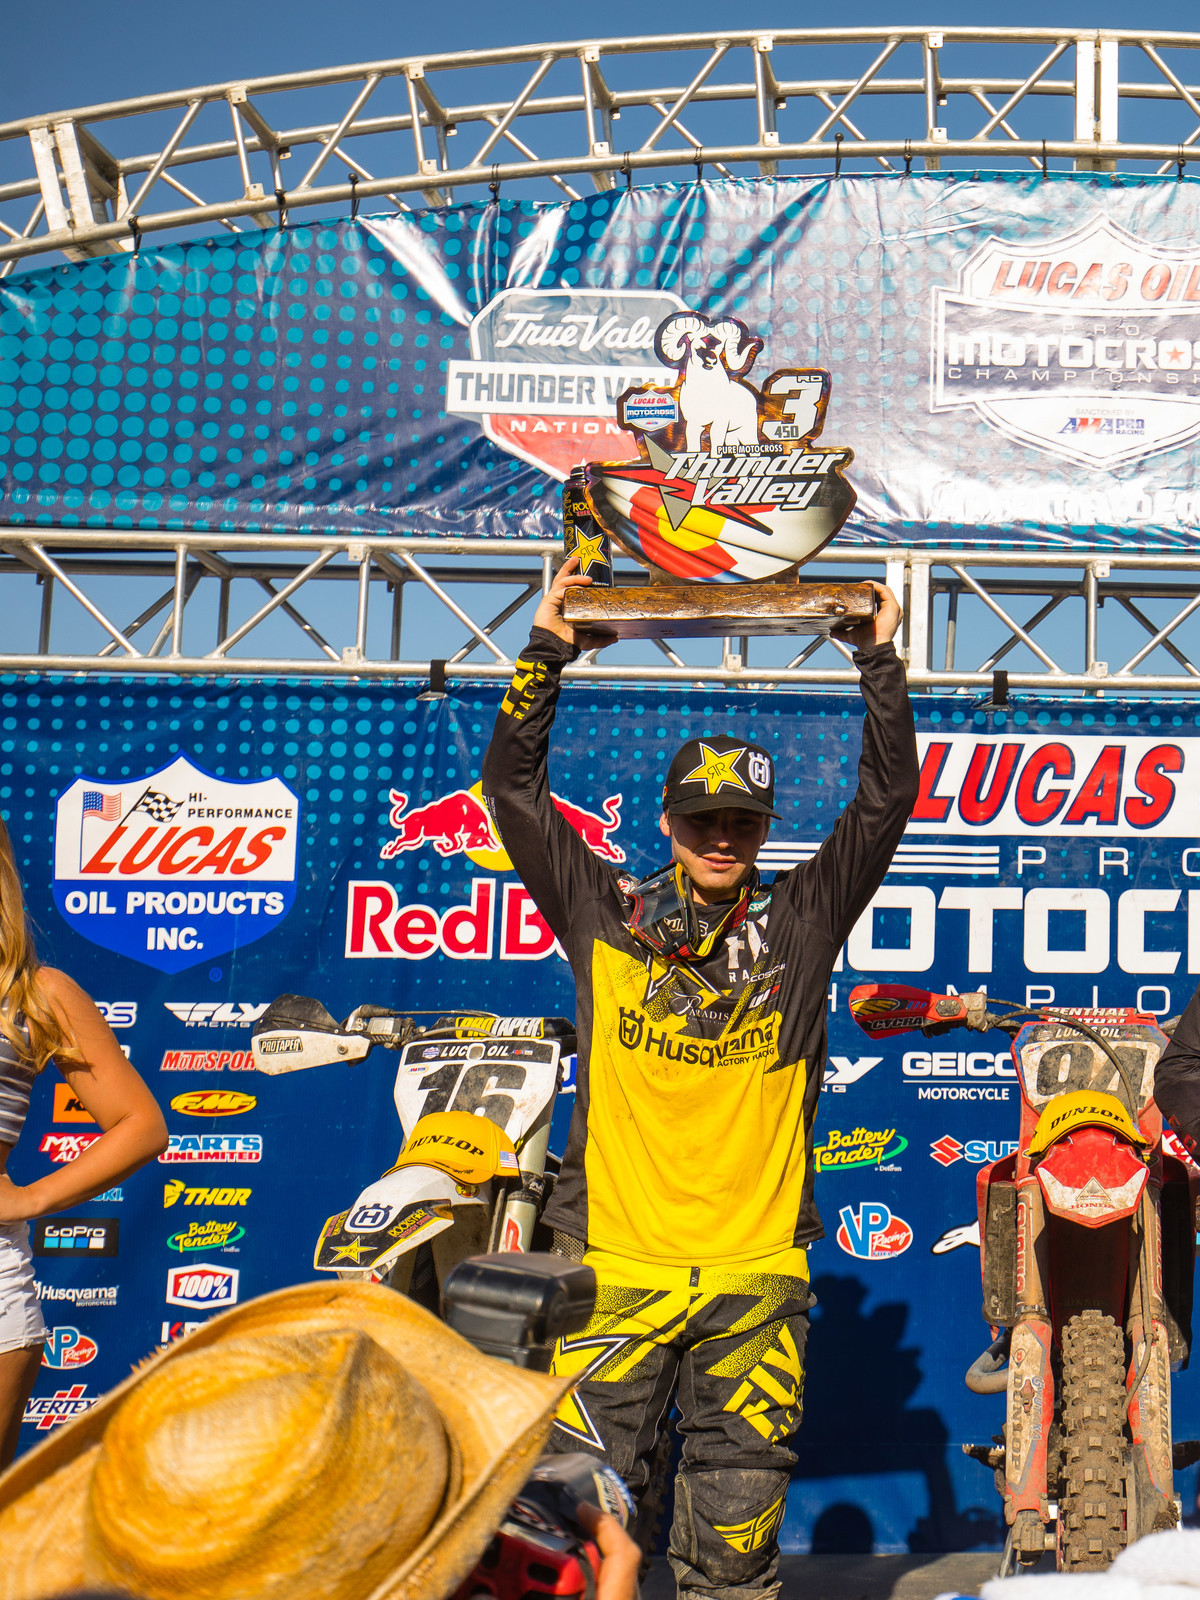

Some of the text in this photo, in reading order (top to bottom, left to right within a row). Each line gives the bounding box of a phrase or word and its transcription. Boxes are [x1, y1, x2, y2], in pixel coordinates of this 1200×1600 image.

[990, 261, 1132, 301] LUCAS
[1062, 324, 1140, 336] PRO
[455, 372, 599, 404] THUNDER
[627, 408, 675, 416] MOTOCROSS
[511, 420, 634, 434] NATION
[774, 425, 799, 439] 450
[717, 444, 783, 455] PURE MOTOCROSS
[664, 448, 845, 481] Thunder
[690, 474, 823, 511] Valley
[911, 742, 1185, 829] LUCAS
[188, 793, 208, 802] HI-
[188, 808, 293, 819] PERFORMANCE
[80, 826, 287, 875] LUCAS
[64, 891, 285, 915] OIL PRODUCTS
[347, 880, 495, 958] Red
[147, 927, 204, 950] INC.
[1100, 1027, 1121, 1038] OIL
[487, 1046, 509, 1057] OIL
[645, 1019, 776, 1068] Husqvarna
[712, 1056, 750, 1068] ACTORY
[903, 1052, 1018, 1077] GEICO
[171, 1093, 257, 1111] FMF
[417, 1063, 527, 1138] 16
[918, 1088, 1010, 1101] MOTORCYCLE
[1049, 1106, 1125, 1131] DUNLOP
[42, 1136, 81, 1152] MX
[168, 1136, 260, 1151] PARTS
[408, 1134, 485, 1156] DUNLOP
[828, 1128, 896, 1151] Battery
[159, 1151, 260, 1163] UNLIMITED
[814, 1145, 885, 1173] Tender
[184, 1188, 252, 1206] THOR
[1071, 1202, 1116, 1210] HONDA
[45, 1225, 105, 1238] GoPro
[188, 1220, 237, 1238] Battery
[840, 1203, 892, 1258] VP
[175, 1234, 229, 1252] Tender
[872, 1231, 911, 1251] Racing
[41, 1285, 117, 1302] Husqvarna
[177, 1275, 230, 1298] 100%
